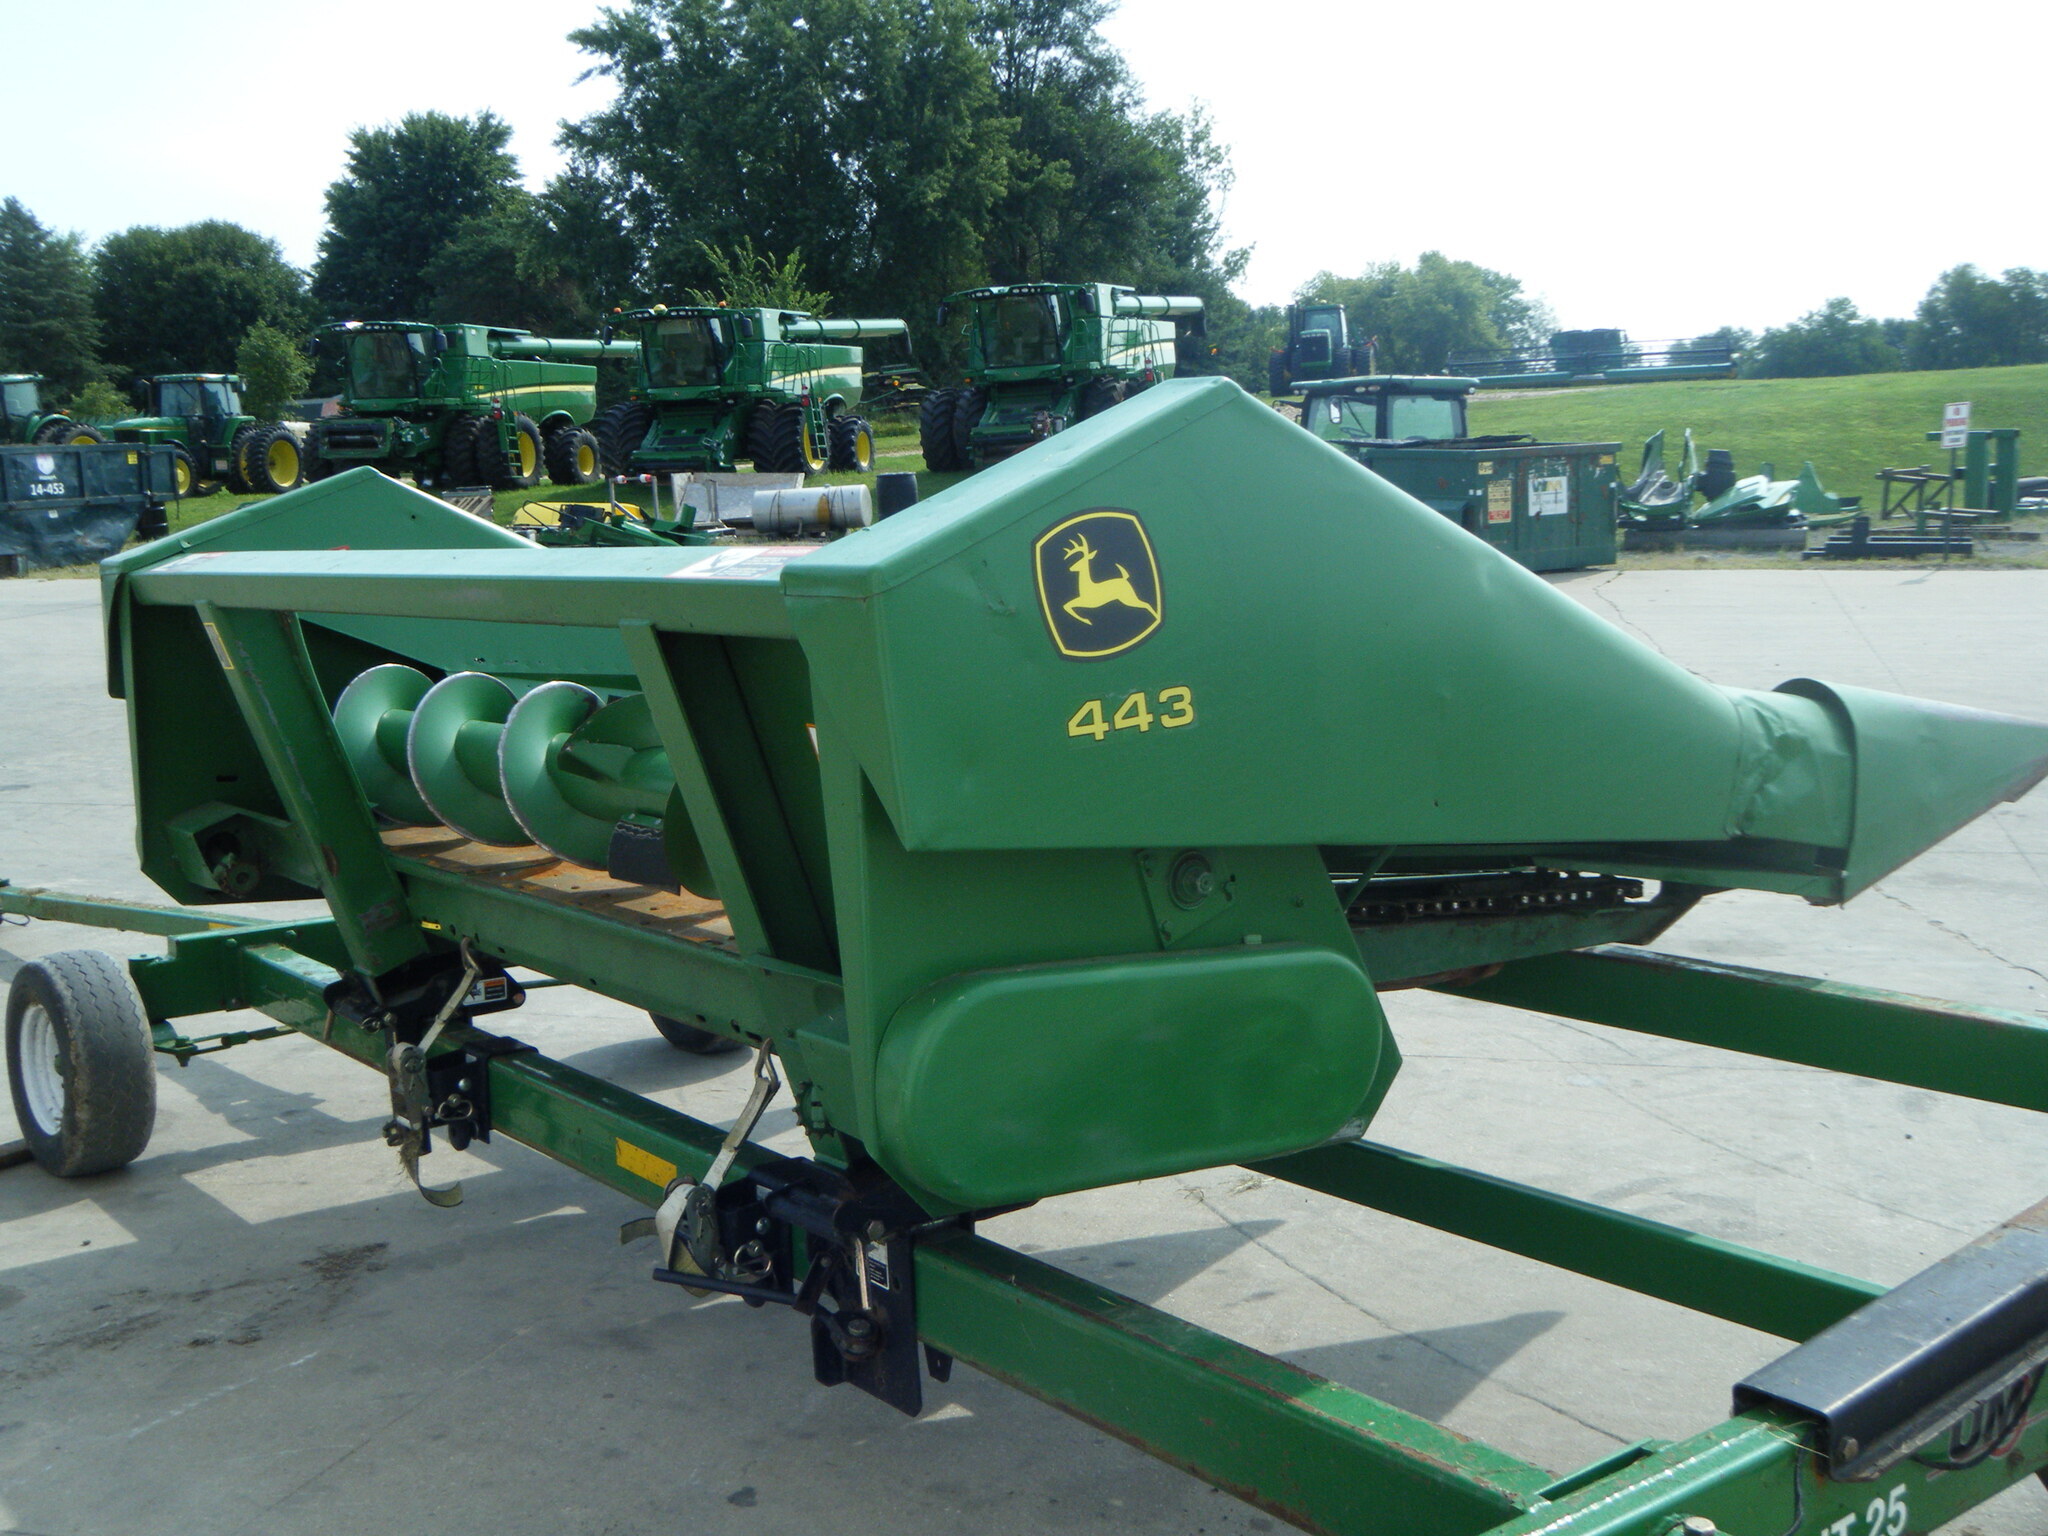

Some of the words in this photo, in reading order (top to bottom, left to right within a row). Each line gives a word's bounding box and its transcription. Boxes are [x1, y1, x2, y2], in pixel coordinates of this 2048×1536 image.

[30, 482, 65, 496] 14-453
[1067, 685, 1195, 741] 443
[1865, 1483, 1908, 1536] 25
